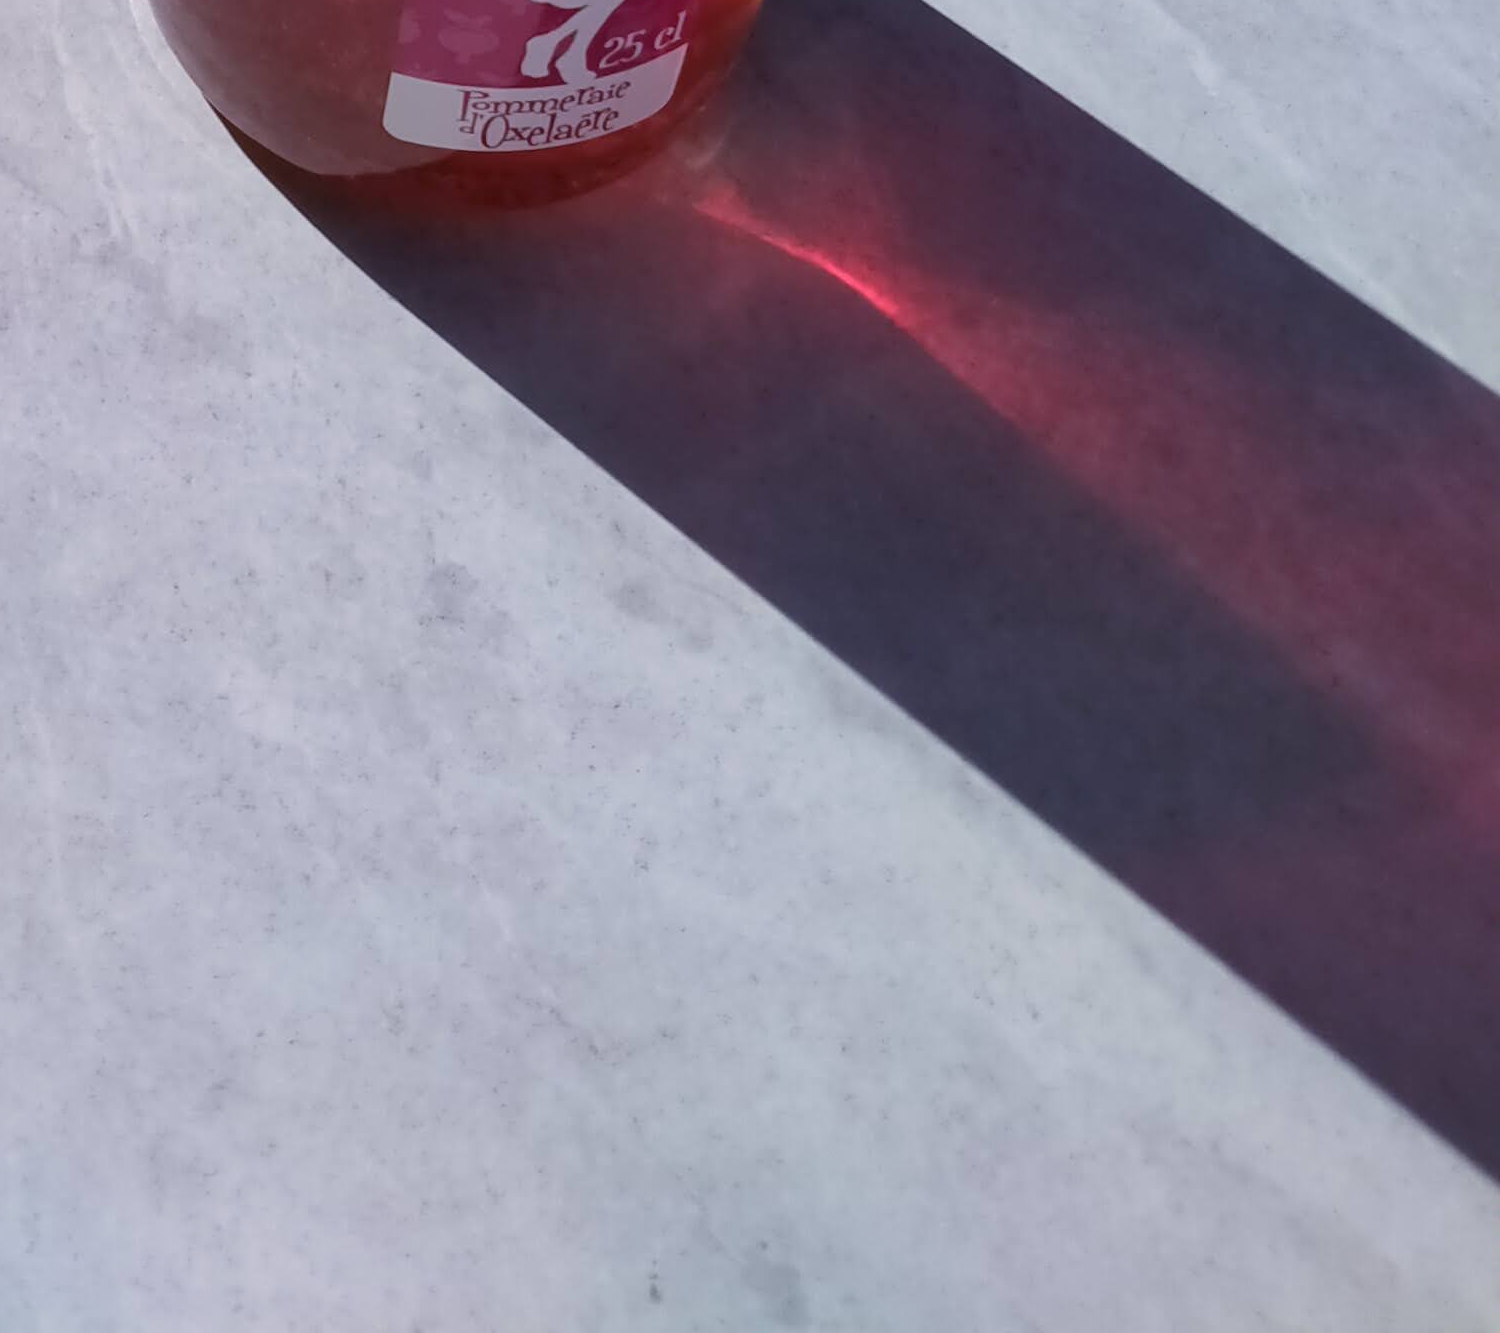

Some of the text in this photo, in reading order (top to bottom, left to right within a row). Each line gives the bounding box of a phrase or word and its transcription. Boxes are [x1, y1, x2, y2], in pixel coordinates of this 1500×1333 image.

[599, 9, 687, 70] 25 cl
[458, 80, 632, 123] Pommeraie
